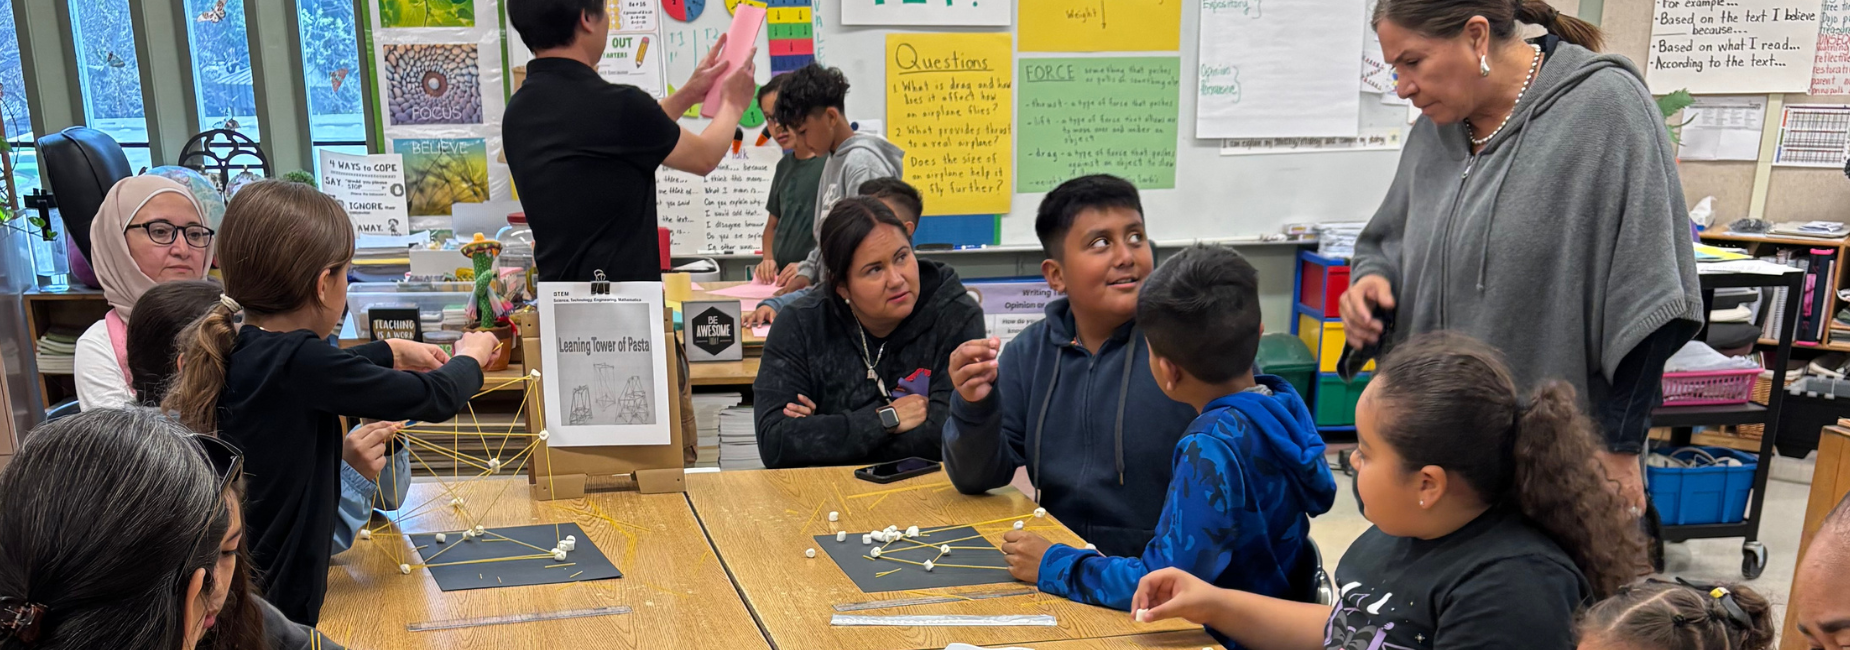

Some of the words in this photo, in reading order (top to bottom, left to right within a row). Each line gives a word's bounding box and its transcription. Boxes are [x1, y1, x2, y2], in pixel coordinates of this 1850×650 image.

[1066, 6, 1096, 23] Weight
[1660, 12, 1694, 25] Based
[1700, 15, 1714, 24] on
[1720, 10, 1738, 23] the
[1745, 10, 1768, 22] text
[1772, 8, 1780, 22] I
[1784, 8, 1816, 22] believe
[1692, 22, 1748, 36] because...
[612, 37, 633, 48] OUT
[1658, 39, 1693, 52] Based
[1698, 43, 1712, 52] on
[1717, 38, 1745, 51] what
[1749, 36, 1758, 50] I
[1761, 36, 1800, 51] read...
[895, 42, 988, 70] Questions
[1654, 56, 1703, 72] According
[1708, 56, 1720, 68] to
[1725, 54, 1744, 67] the
[1750, 54, 1786, 67] text...
[1025, 64, 1075, 80] FORCE
[1129, 64, 1144, 74] that
[902, 80, 928, 92] What
[935, 82, 944, 90] is
[978, 76, 994, 89] and
[929, 94, 936, 102] it
[942, 90, 974, 102] affect
[980, 90, 996, 100] how
[1078, 99, 1094, 109] type
[1098, 98, 1106, 107] of
[1110, 98, 1128, 107] force
[1132, 99, 1146, 107] that
[412, 106, 462, 120] FOCUS
[922, 104, 962, 120] airplane
[968, 102, 998, 115] flies?
[1068, 116, 1085, 126] type
[1088, 115, 1096, 123] of
[1100, 115, 1120, 123] force
[906, 126, 932, 134] What
[938, 122, 980, 137] provides
[986, 122, 1011, 135] thrust
[412, 141, 468, 154] BELIEVE
[908, 139, 917, 148] to
[932, 136, 951, 147] real
[958, 136, 999, 149] airplane?
[910, 156, 936, 167] Does
[943, 152, 957, 164] the
[962, 153, 982, 164] size
[986, 152, 997, 164] of
[1036, 148, 1057, 162] drag
[1075, 150, 1092, 160] type
[1095, 148, 1103, 157] of
[330, 159, 335, 167] 4
[338, 161, 361, 170] WAYS
[374, 164, 397, 172] COPE
[743, 163, 767, 171] because
[926, 167, 963, 182] airplane
[970, 166, 990, 179] help
[995, 167, 1002, 177] it
[930, 182, 944, 197] fly
[950, 179, 1003, 195] further?
[349, 202, 383, 210] IGNORE
[729, 198, 748, 208] explain
[715, 221, 741, 230] disagree
[719, 233, 729, 242] you
[1023, 289, 1051, 298] Writing
[1004, 302, 1035, 310] Opinion
[374, 320, 415, 330] TEACHING
[708, 316, 718, 324] BE
[696, 324, 731, 337] AWESOME
[558, 336, 591, 356] Leaning
[591, 337, 616, 352] Tower
[618, 336, 626, 352] of
[628, 336, 650, 352] Pasta
